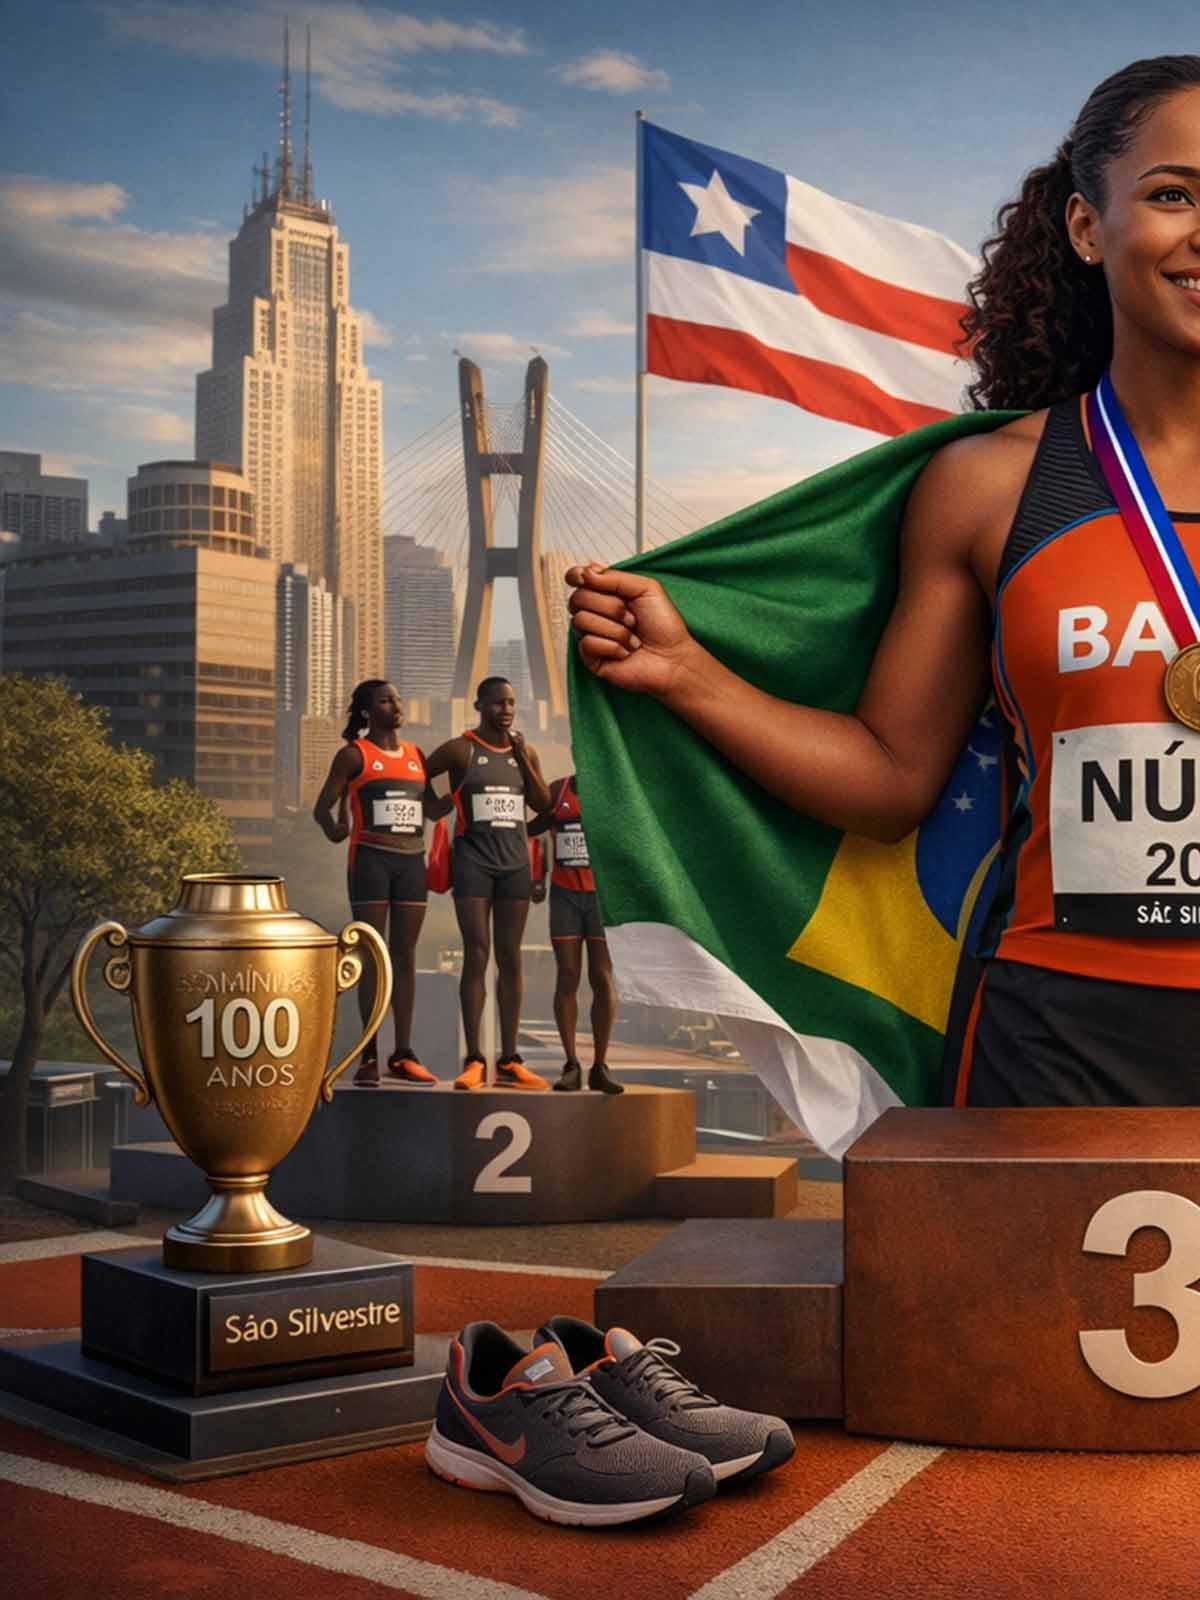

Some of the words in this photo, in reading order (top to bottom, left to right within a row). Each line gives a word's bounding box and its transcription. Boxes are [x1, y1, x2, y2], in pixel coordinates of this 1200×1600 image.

[185, 997, 300, 1059] 100
[206, 1063, 295, 1088] ANOS
[473, 1111, 532, 1193] 2
[288, 1301, 401, 1337] Silvestre
